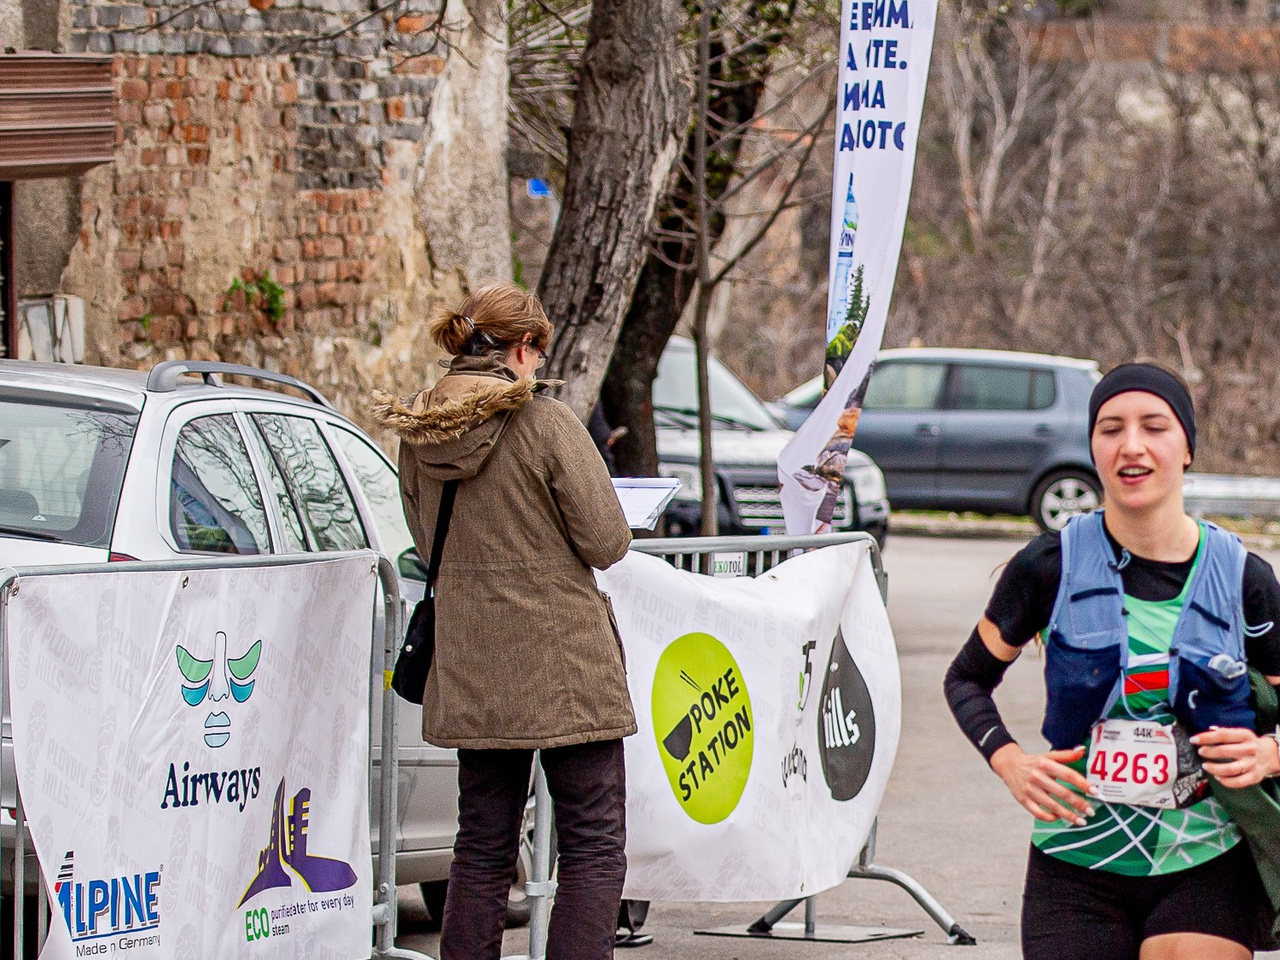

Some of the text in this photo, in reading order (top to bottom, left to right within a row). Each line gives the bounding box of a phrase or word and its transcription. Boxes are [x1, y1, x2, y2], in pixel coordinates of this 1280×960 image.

[690, 667, 739, 734] POKE
[679, 705, 751, 802] STATION
[1090, 750, 1169, 786] 4263
[160, 761, 261, 813] Airways
[308, 899, 319, 912] for
[321, 897, 341, 911] every
[343, 893, 354, 908] day
[245, 907, 270, 942] ECO
[272, 924, 290, 936] steam
[76, 942, 107, 957] Made
[119, 934, 161, 951] Germany
